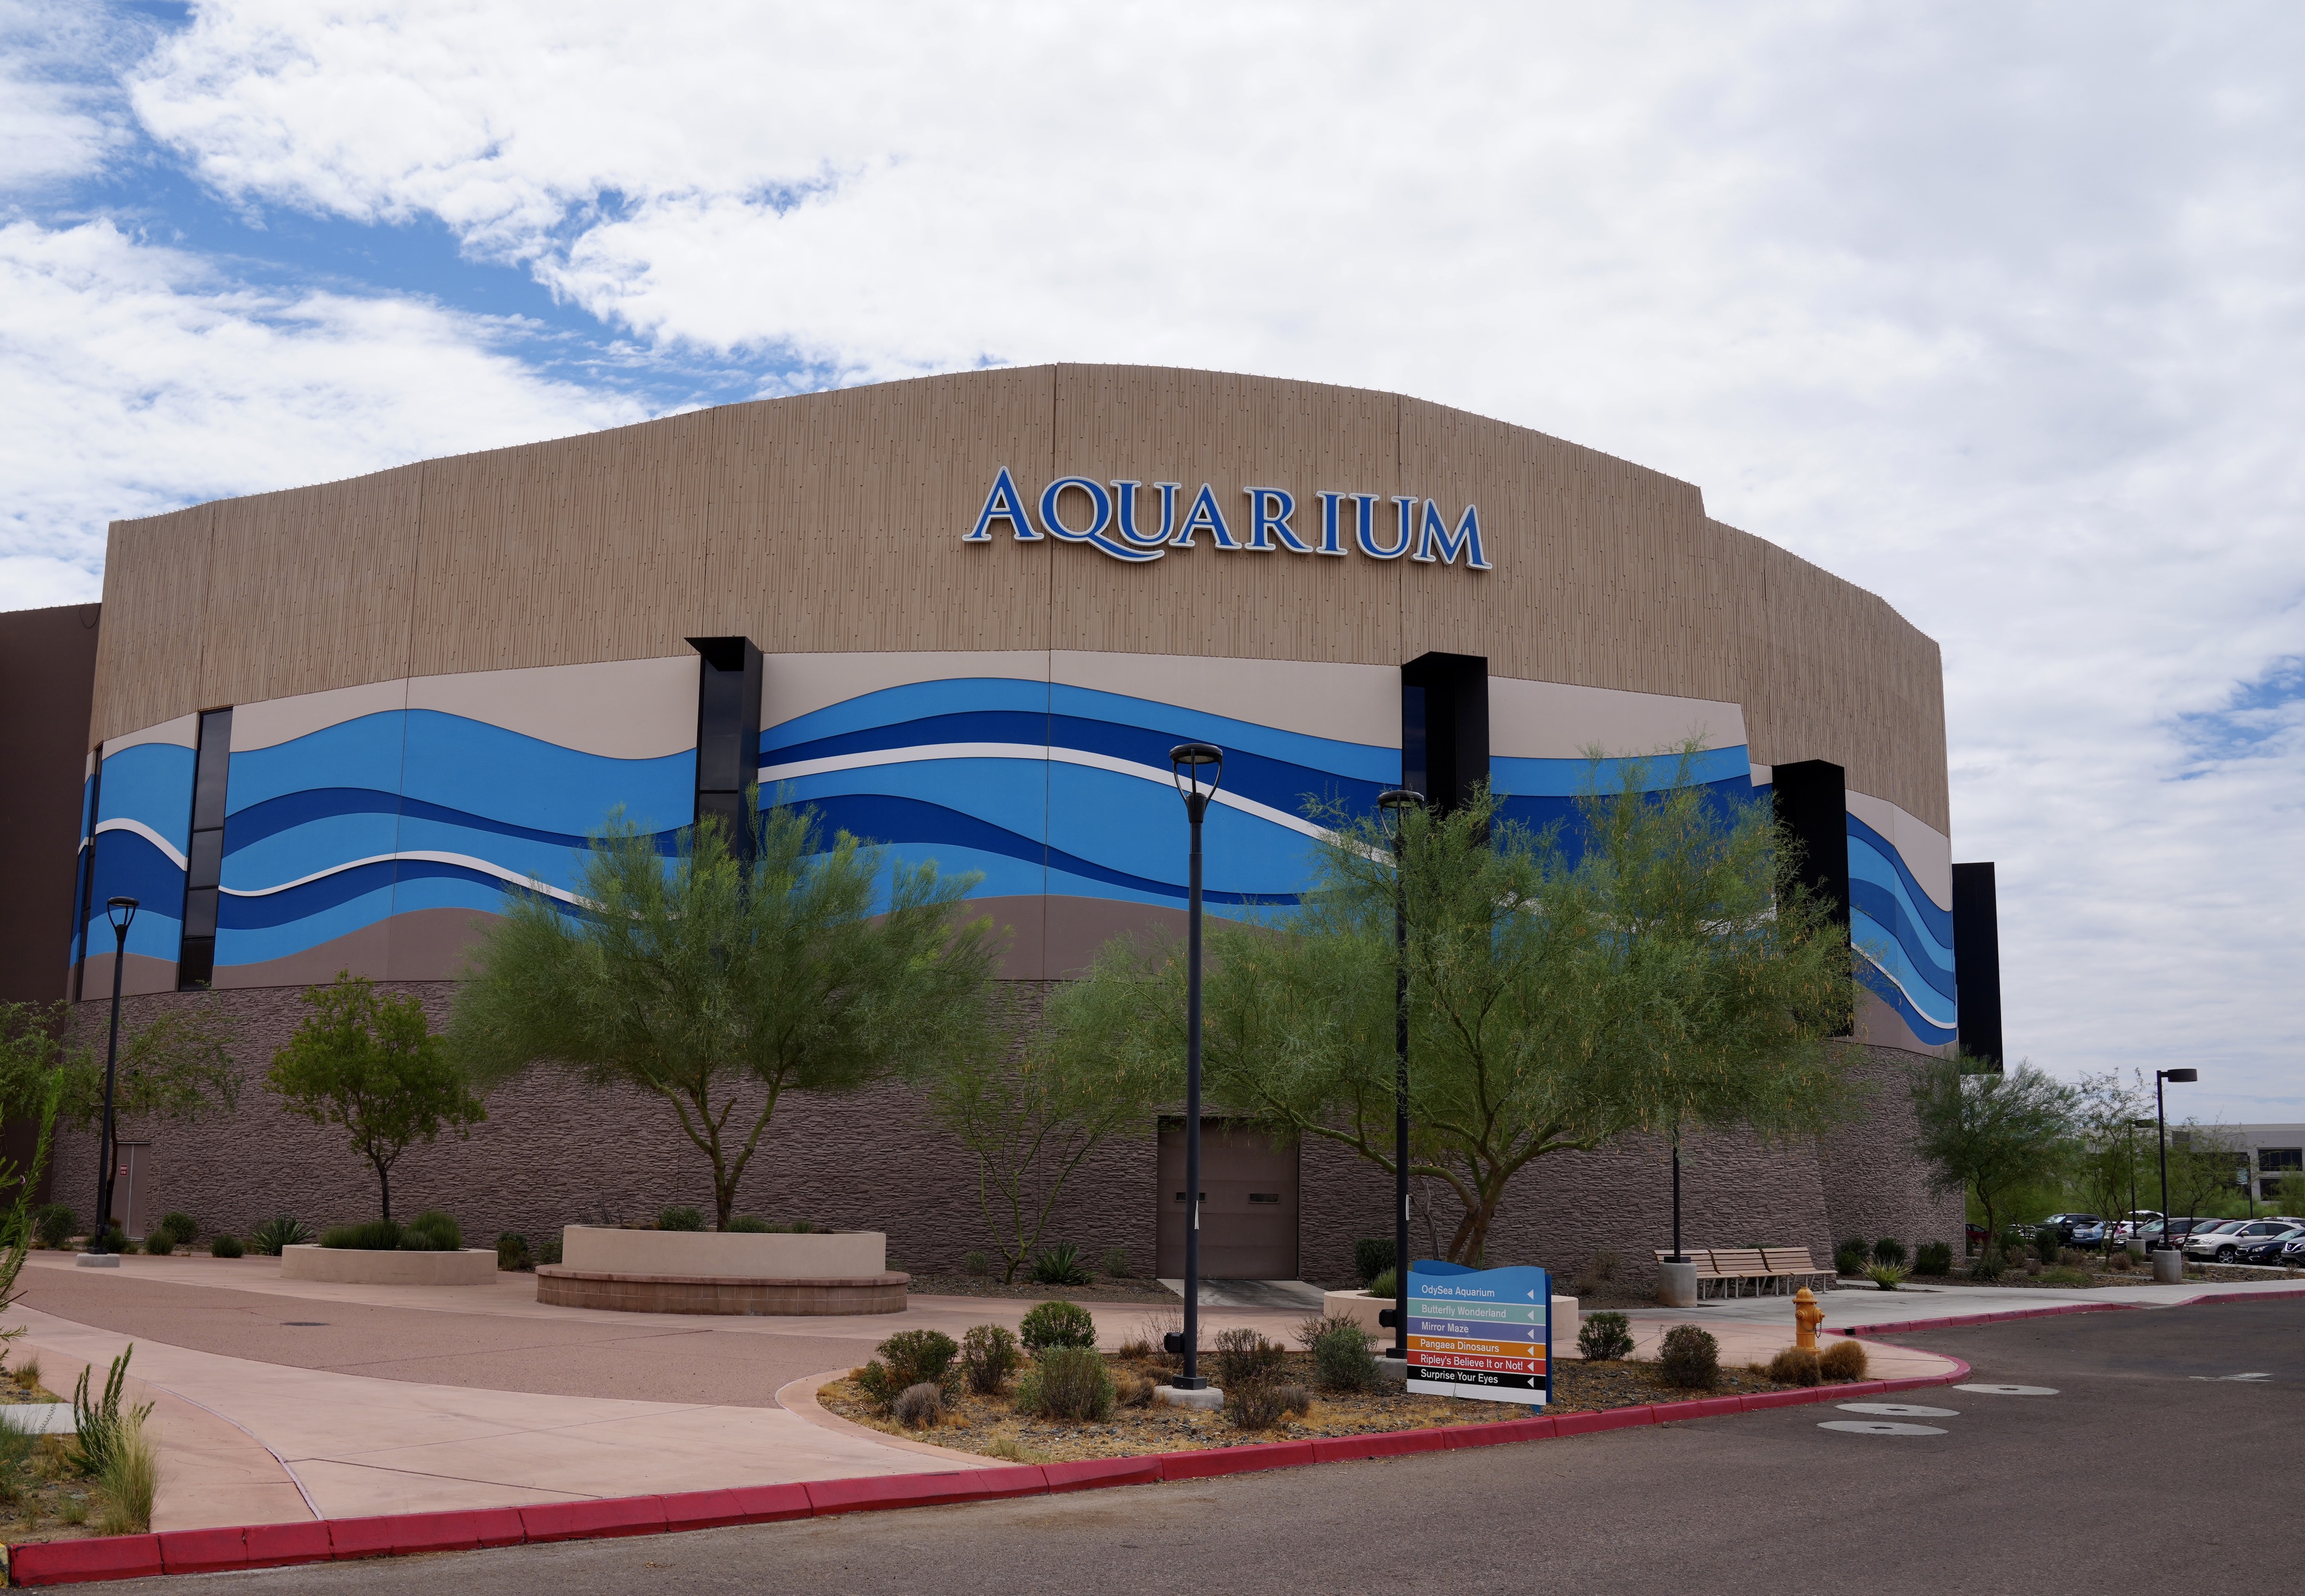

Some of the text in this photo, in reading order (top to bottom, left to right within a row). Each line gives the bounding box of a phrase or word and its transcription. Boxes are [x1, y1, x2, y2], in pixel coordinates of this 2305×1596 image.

[962, 466, 1493, 571] AQUARIUM
[1422, 1284, 1495, 1297] OdySea Aquarium
[1422, 1304, 1506, 1318] Butterfly Wonderland
[1422, 1321, 1469, 1333] Mirror Maze
[1420, 1338, 1500, 1352] Pangaea Dinosaurs
[1421, 1354, 1451, 1366] Ripley’s
[1454, 1356, 1484, 1367] Believe
[1487, 1359, 1492, 1368] It
[1506, 1360, 1523, 1370] Not!
[1421, 1368, 1498, 1384] Surprise Your Eyes
